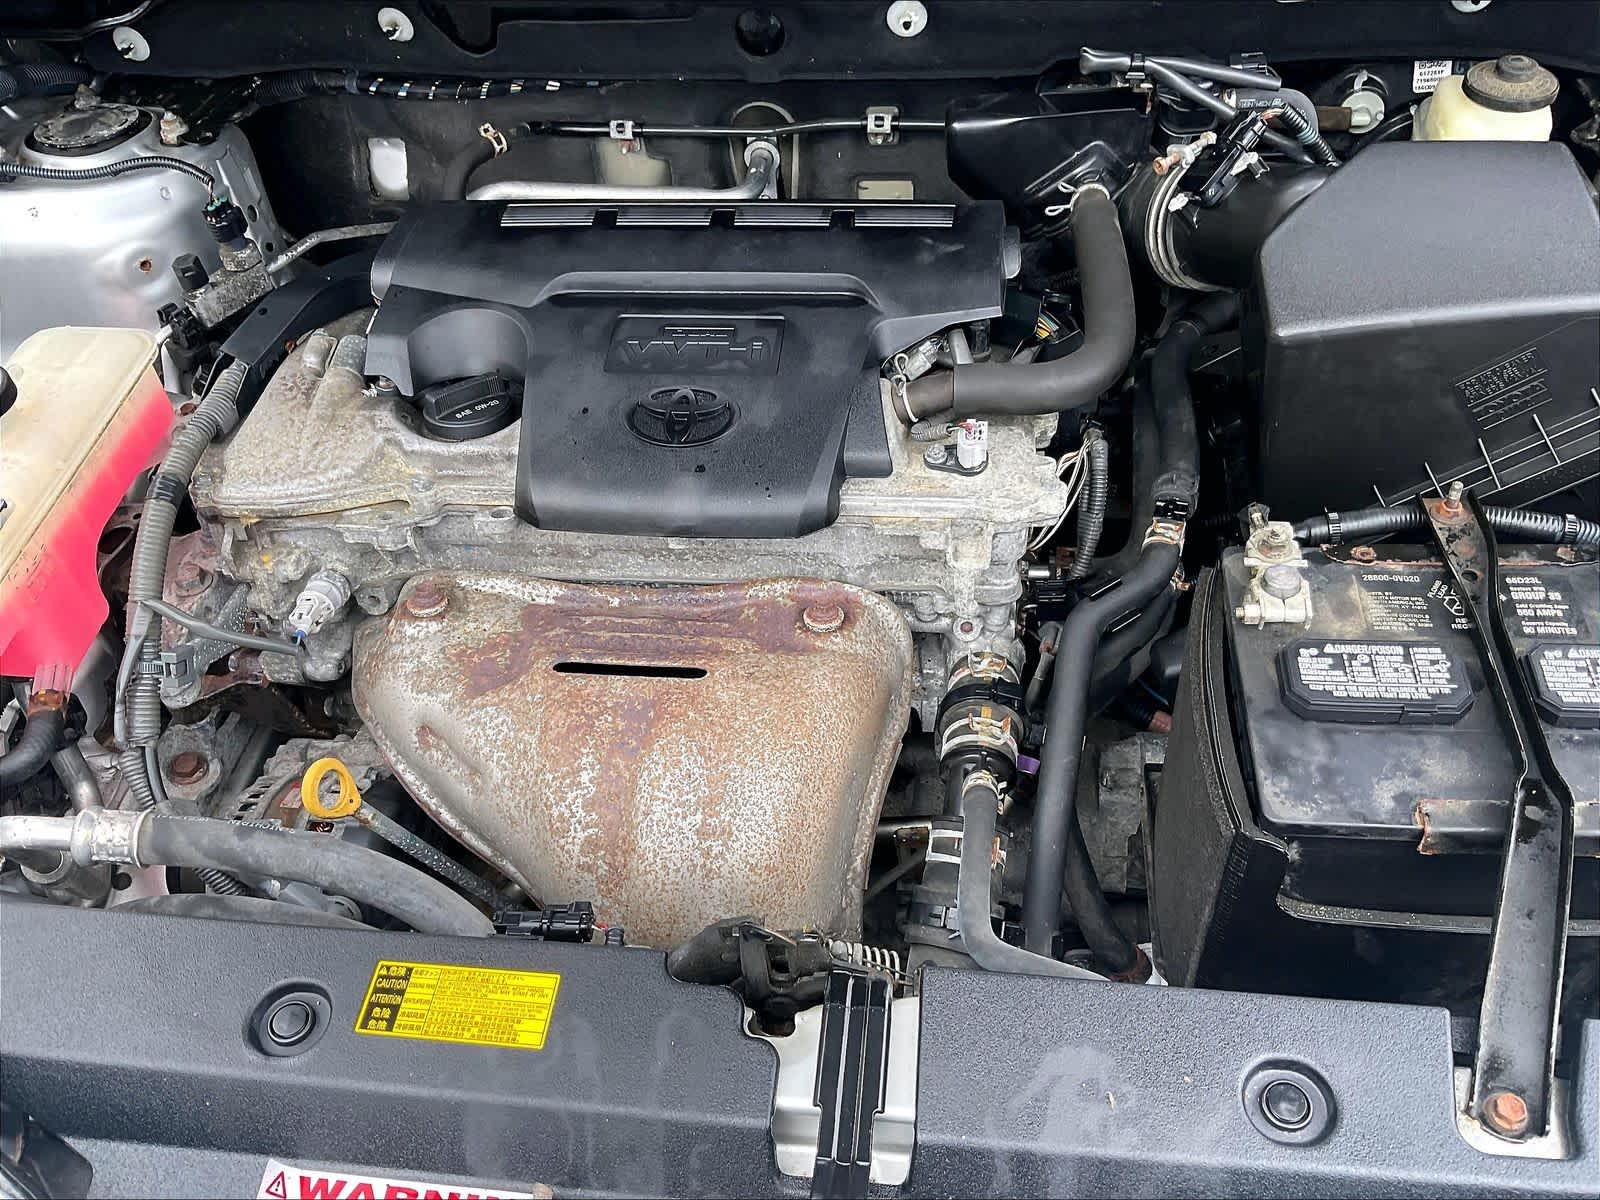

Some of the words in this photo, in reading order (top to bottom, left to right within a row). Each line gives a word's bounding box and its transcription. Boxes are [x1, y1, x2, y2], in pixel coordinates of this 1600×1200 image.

[456, 409, 472, 419] SAE
[475, 399, 500, 411] 0W-20
[1511, 591, 1546, 600] GROUP
[1536, 609, 1564, 617] AMPS
[1537, 627, 1578, 635] MINUTES
[376, 978, 408, 989] CAUTION
[370, 993, 402, 1004] ATTENTION
